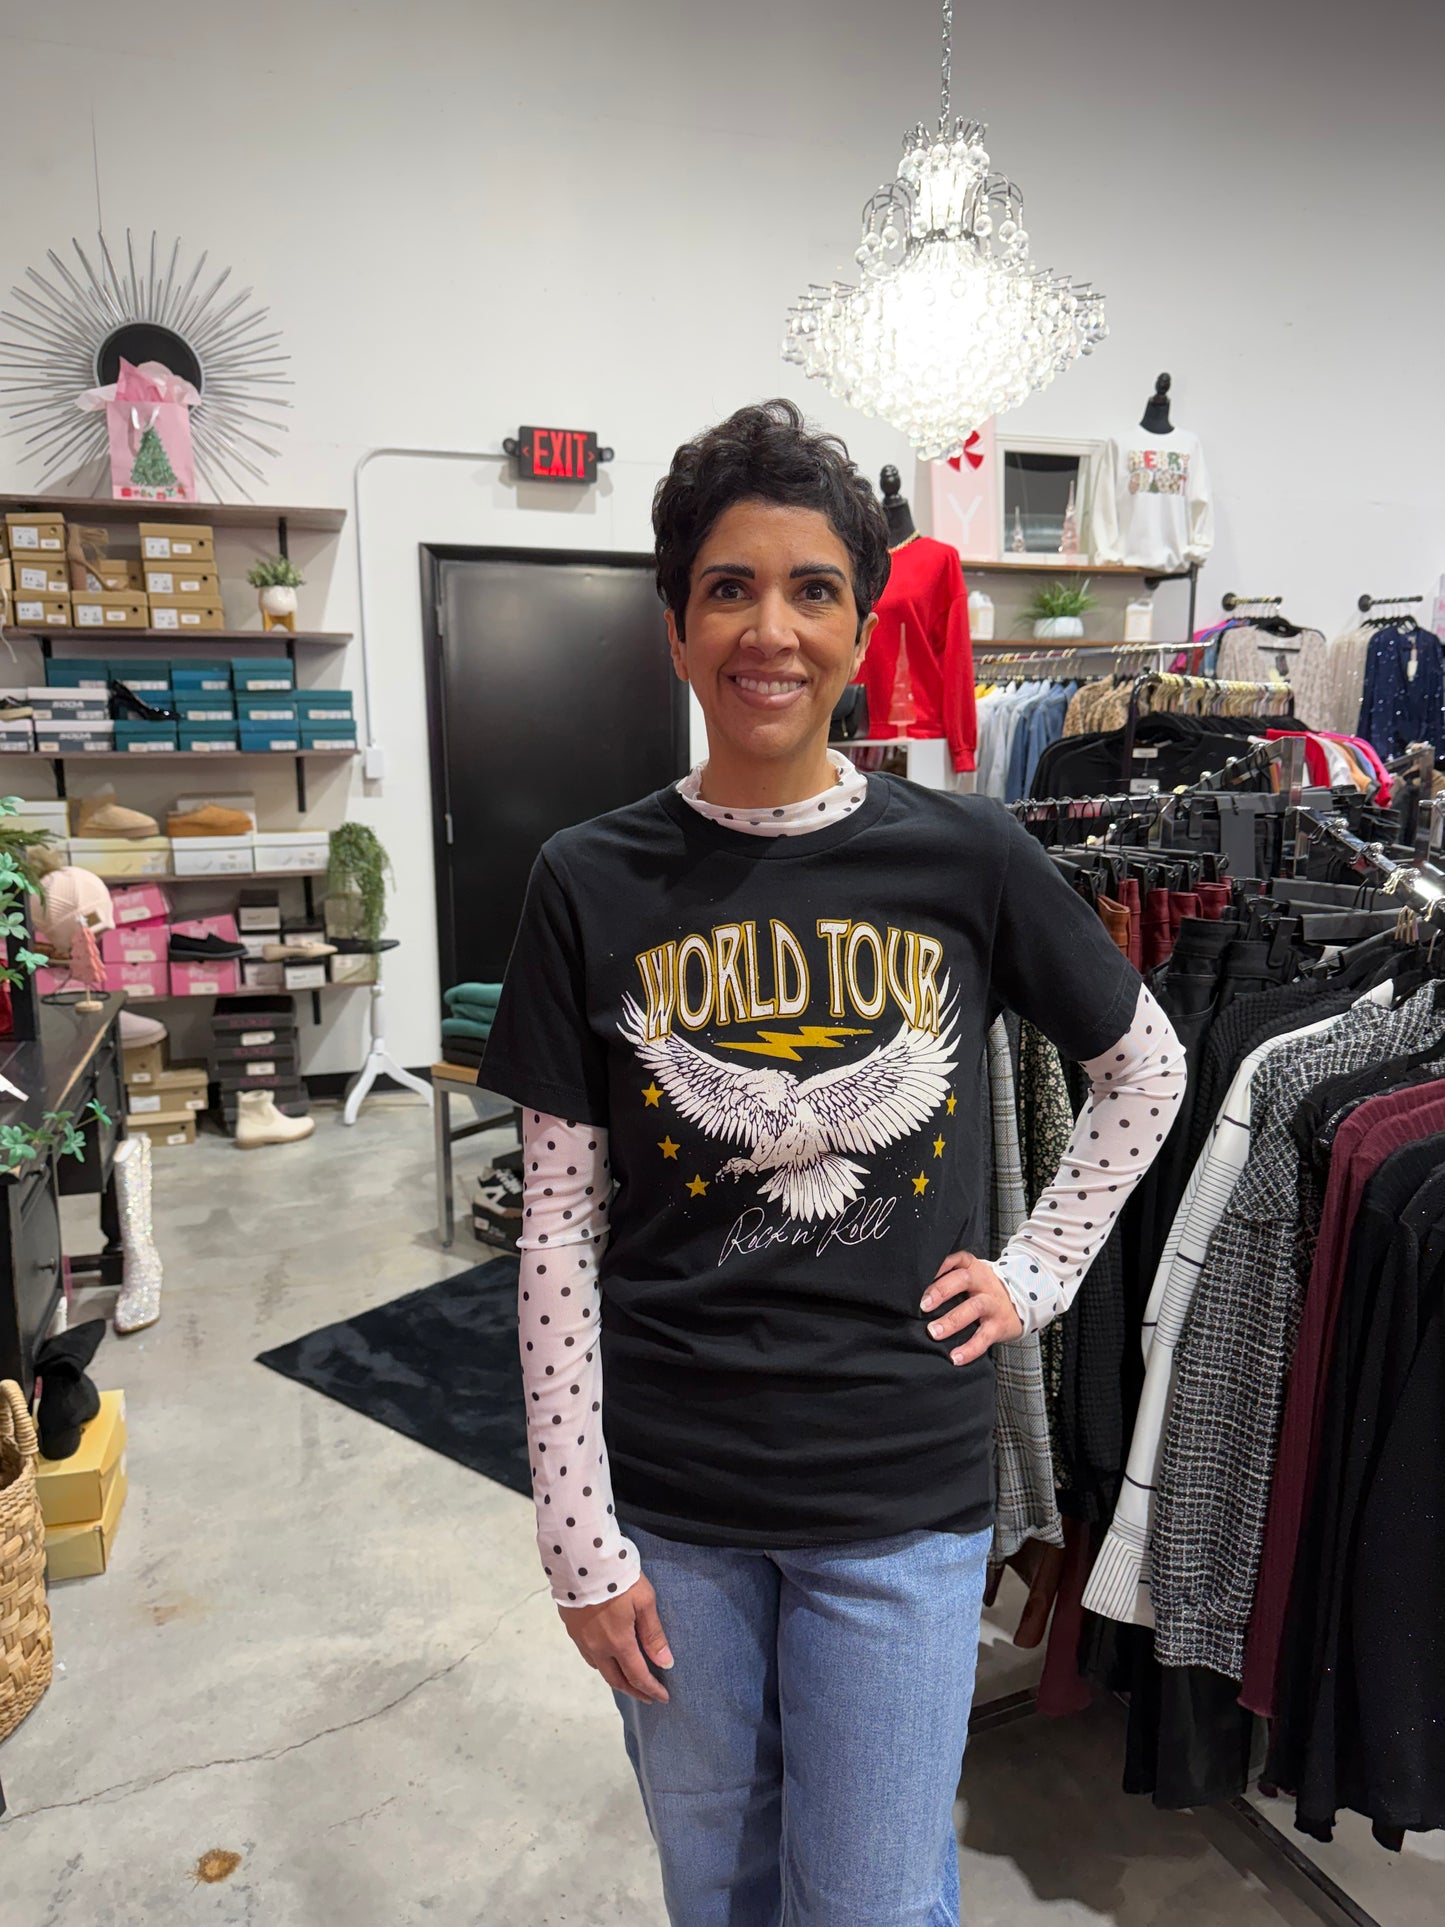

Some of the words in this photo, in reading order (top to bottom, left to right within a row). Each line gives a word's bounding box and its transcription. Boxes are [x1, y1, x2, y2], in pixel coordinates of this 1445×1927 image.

[533, 429, 588, 479] EXIT
[635, 918, 810, 1043] WORLD
[816, 918, 944, 1037] TOUR
[718, 1207, 791, 1267] Rock
[816, 1196, 897, 1258] Roll
